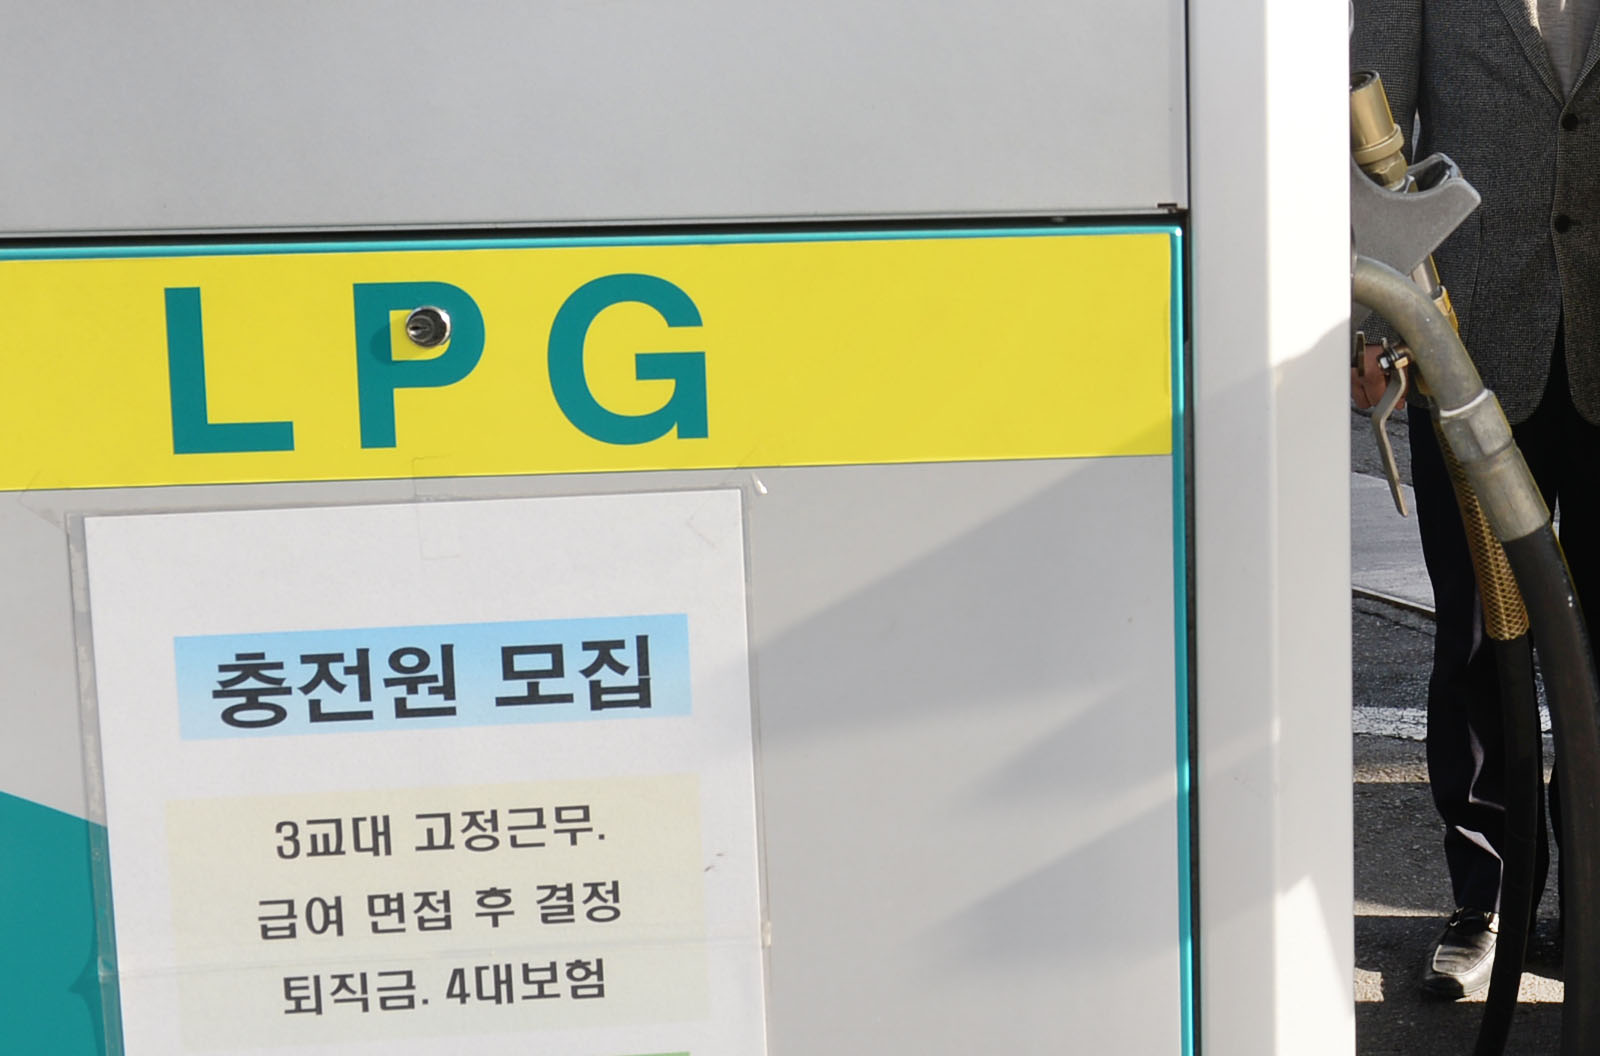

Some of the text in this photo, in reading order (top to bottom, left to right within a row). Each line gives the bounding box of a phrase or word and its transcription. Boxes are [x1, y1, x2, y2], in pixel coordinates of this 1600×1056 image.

[164, 273, 709, 455] LPG
[212, 634, 652, 729] 충전원 모집
[275, 804, 606, 860] 3교대 고정근무.
[258, 880, 622, 940] 급여 면접 후 결정
[283, 958, 606, 1015] 퇴직금. 4대보험
